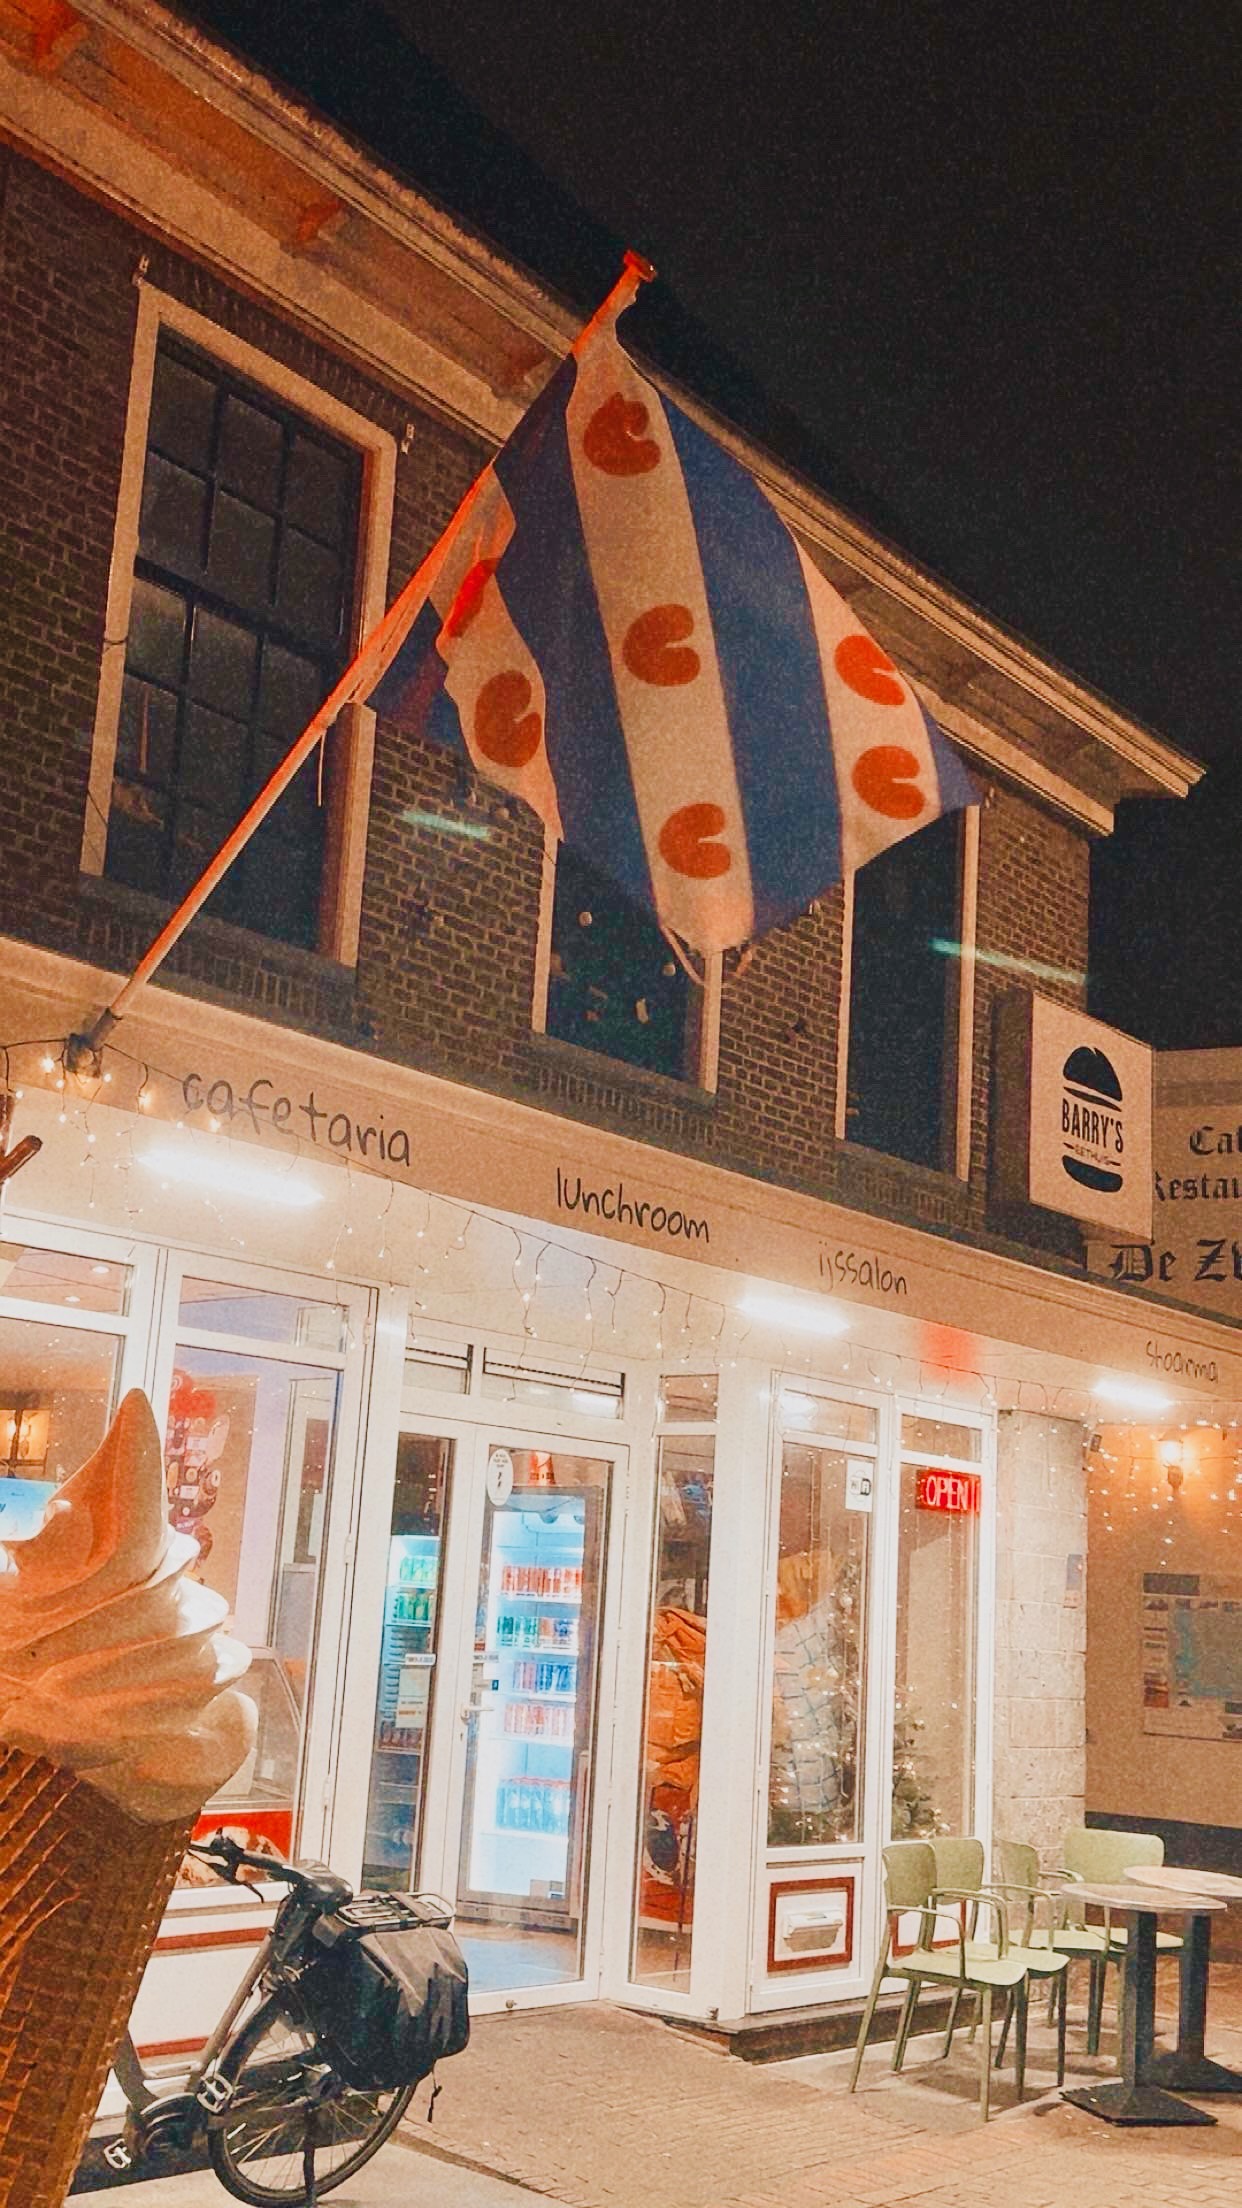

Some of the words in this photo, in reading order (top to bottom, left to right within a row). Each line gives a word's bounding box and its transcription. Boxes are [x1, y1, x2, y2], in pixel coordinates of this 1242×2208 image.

[182, 1073, 410, 1167] cafetaria
[1062, 1098, 1123, 1153] BARRY'S
[557, 1167, 709, 1243] lunchroom
[818, 1240, 907, 1295] ijssalon
[1108, 1242, 1177, 1282] De
[925, 1475, 968, 1511] OPEN
